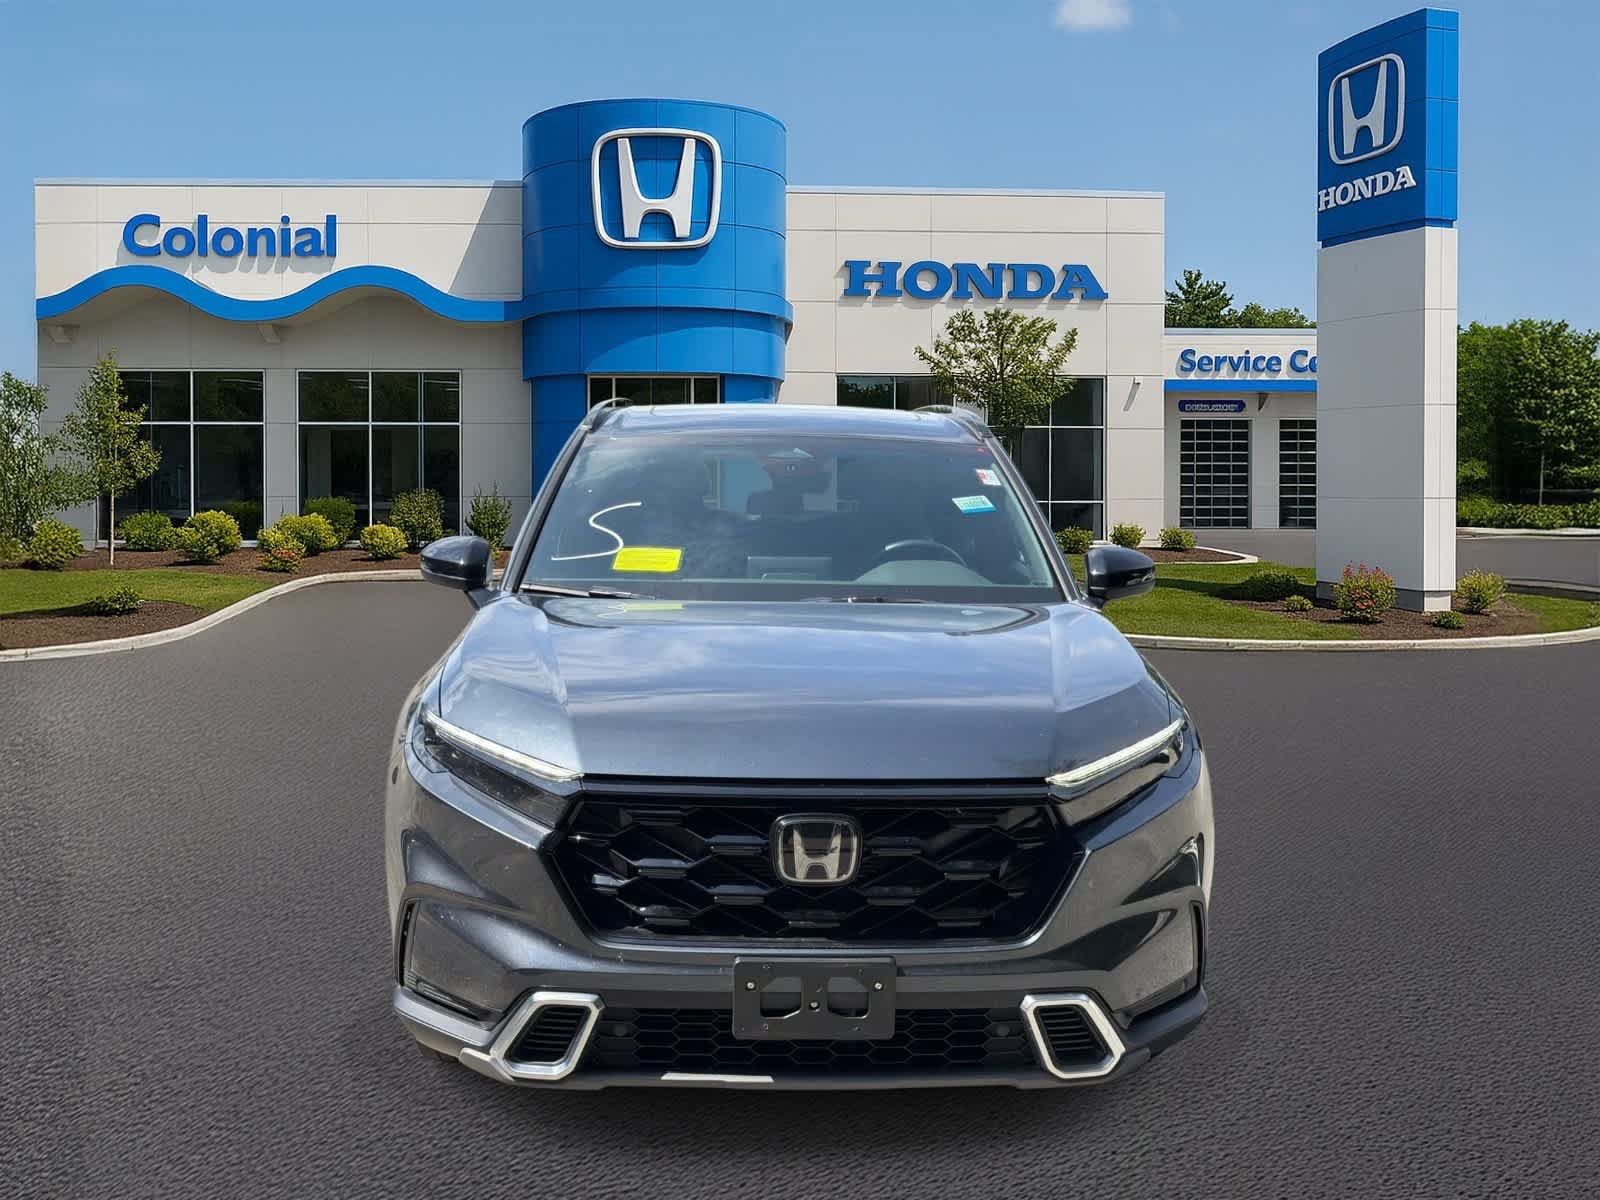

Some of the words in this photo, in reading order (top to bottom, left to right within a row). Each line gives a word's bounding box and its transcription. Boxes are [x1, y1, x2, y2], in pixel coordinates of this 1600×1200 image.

[1317, 165, 1416, 212] HONDA
[122, 213, 337, 258] Colonial
[843, 260, 1109, 300] HONDA
[1180, 349, 1282, 373] Service
